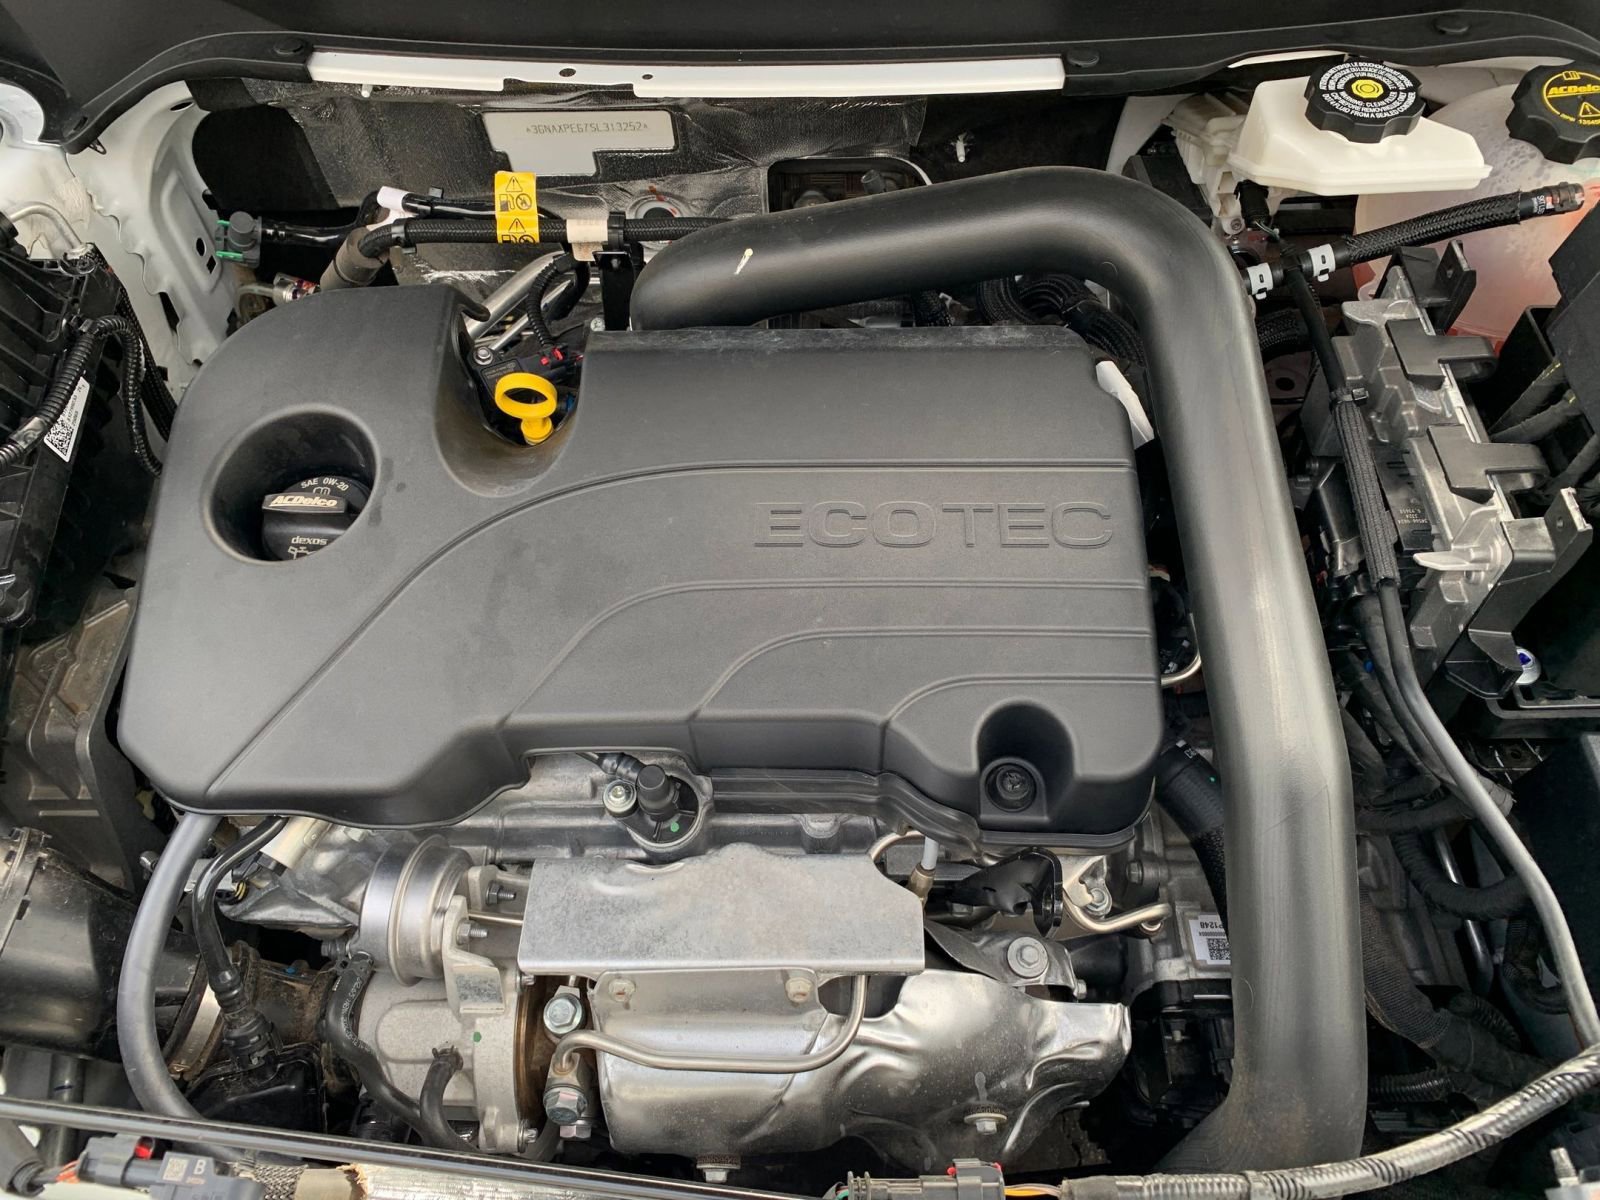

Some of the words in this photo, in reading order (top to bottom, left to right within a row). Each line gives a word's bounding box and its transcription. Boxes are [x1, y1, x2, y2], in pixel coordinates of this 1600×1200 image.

[1548, 84, 1600, 96] ACDelc
[1332, 102, 1350, 113] FLUID
[1350, 110, 1369, 118] FROM
[301, 478, 318, 488] SAE
[323, 477, 349, 492] 0W-20
[269, 495, 338, 508] ACDelco
[754, 500, 1114, 549] ECOTEC
[291, 536, 328, 546] dexos
[193, 1159, 206, 1175] B
